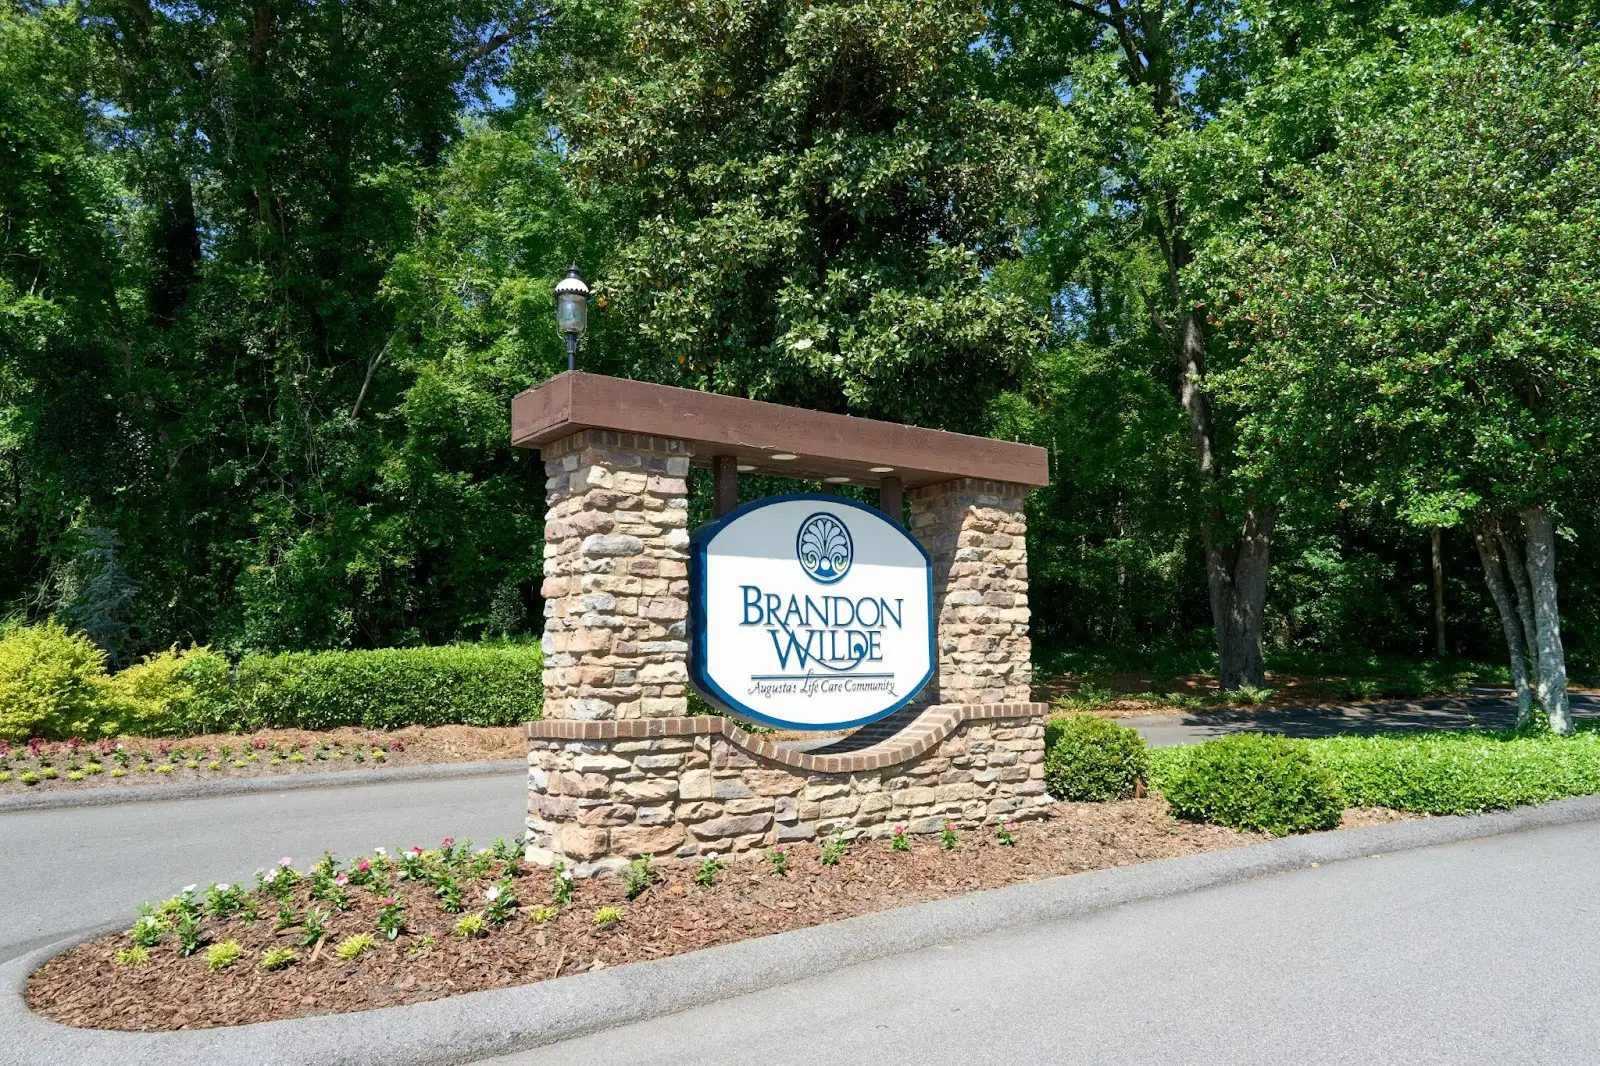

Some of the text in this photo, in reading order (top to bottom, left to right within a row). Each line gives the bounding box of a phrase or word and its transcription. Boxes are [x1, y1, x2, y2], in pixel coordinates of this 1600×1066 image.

[739, 585, 904, 630] BRANDON
[767, 629, 883, 671] WILDE
[800, 668, 819, 697] Life
[821, 679, 843, 693] Care
[844, 678, 899, 697] Community
